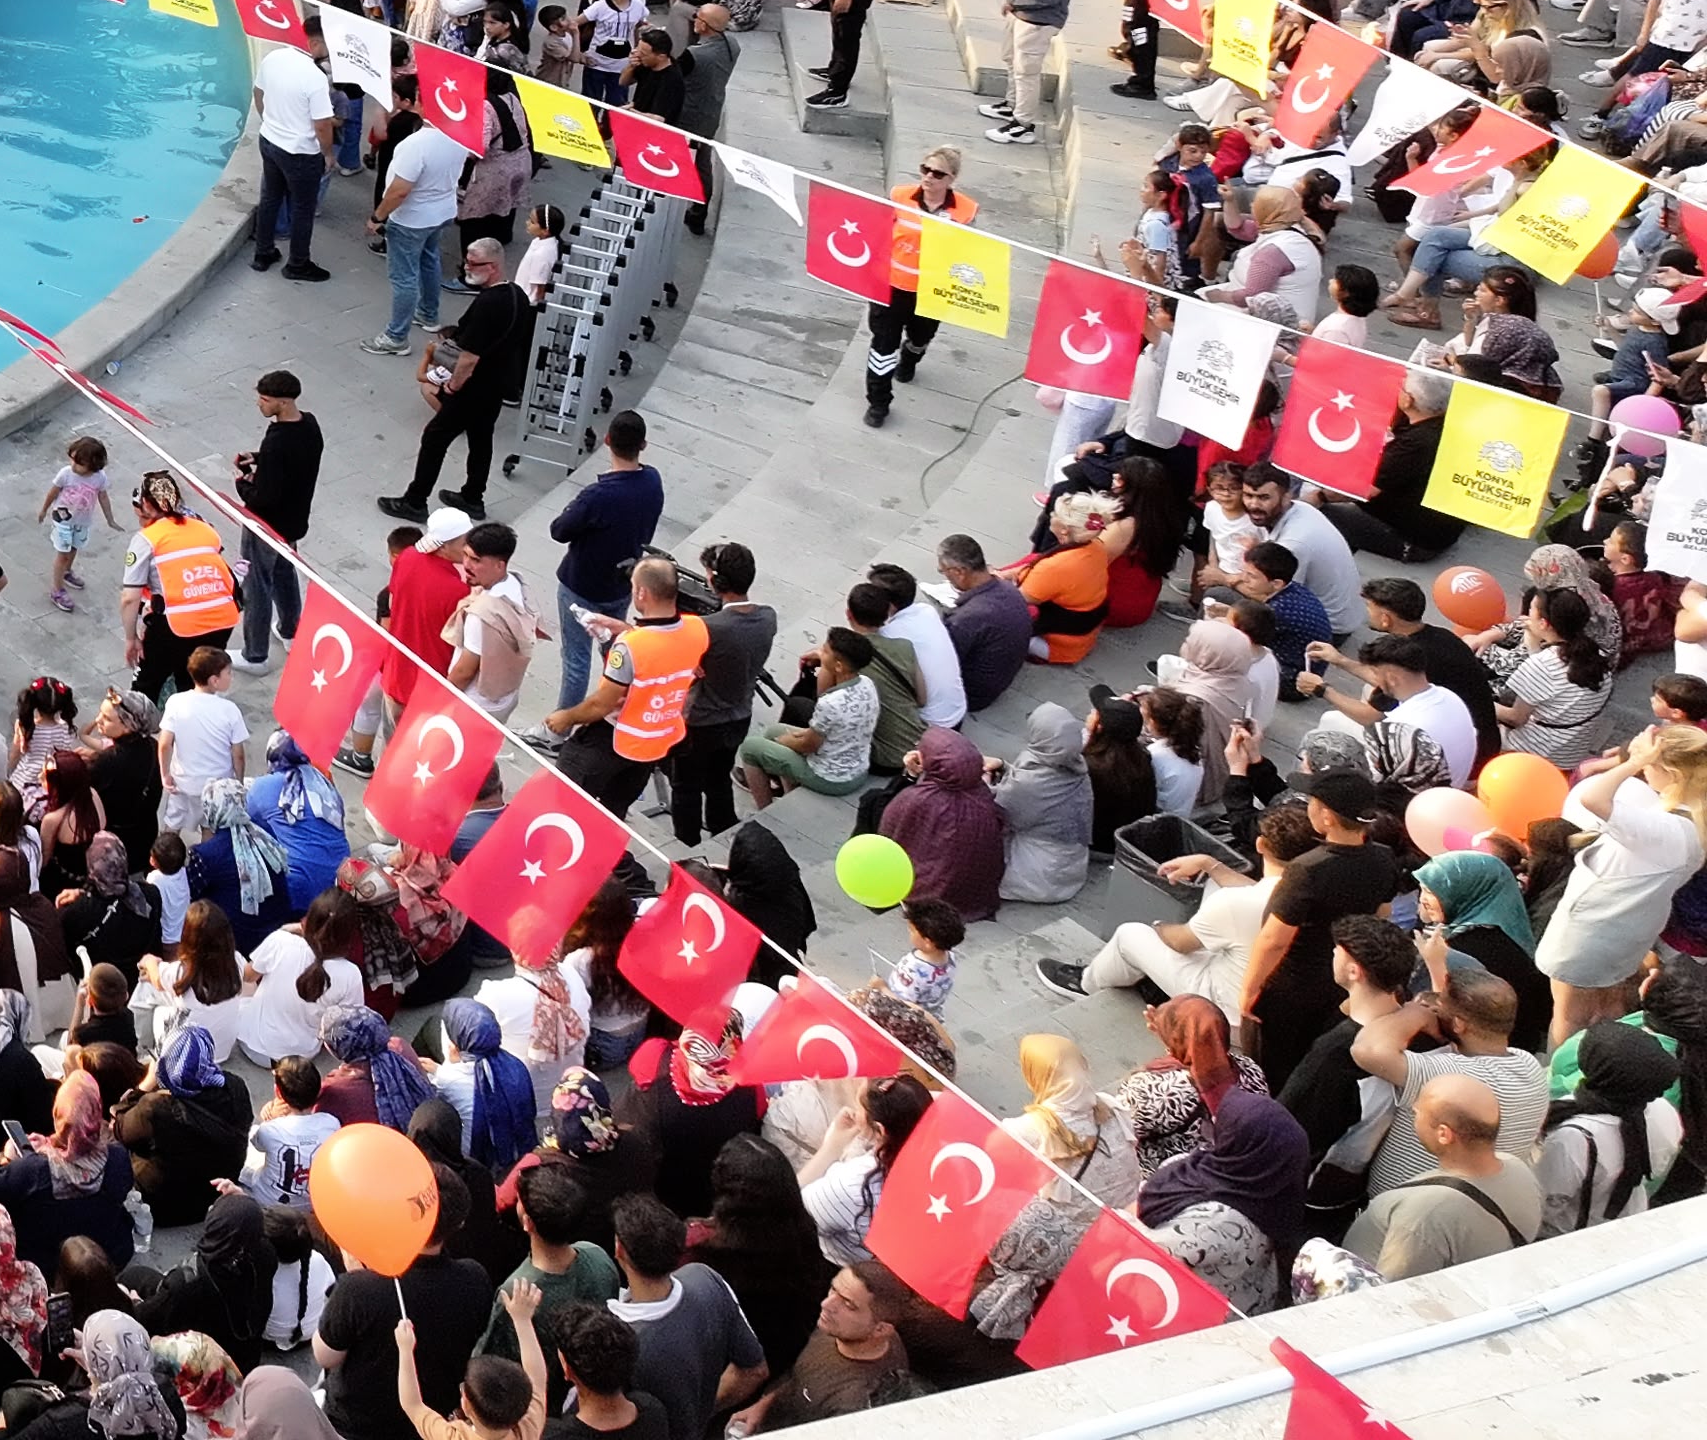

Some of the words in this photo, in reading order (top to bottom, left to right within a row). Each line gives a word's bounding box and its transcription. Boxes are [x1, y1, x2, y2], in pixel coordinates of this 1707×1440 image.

[950, 283, 983, 301] KONYA
[1196, 366, 1226, 387] KONYA
[1475, 469, 1515, 490] KONYA
